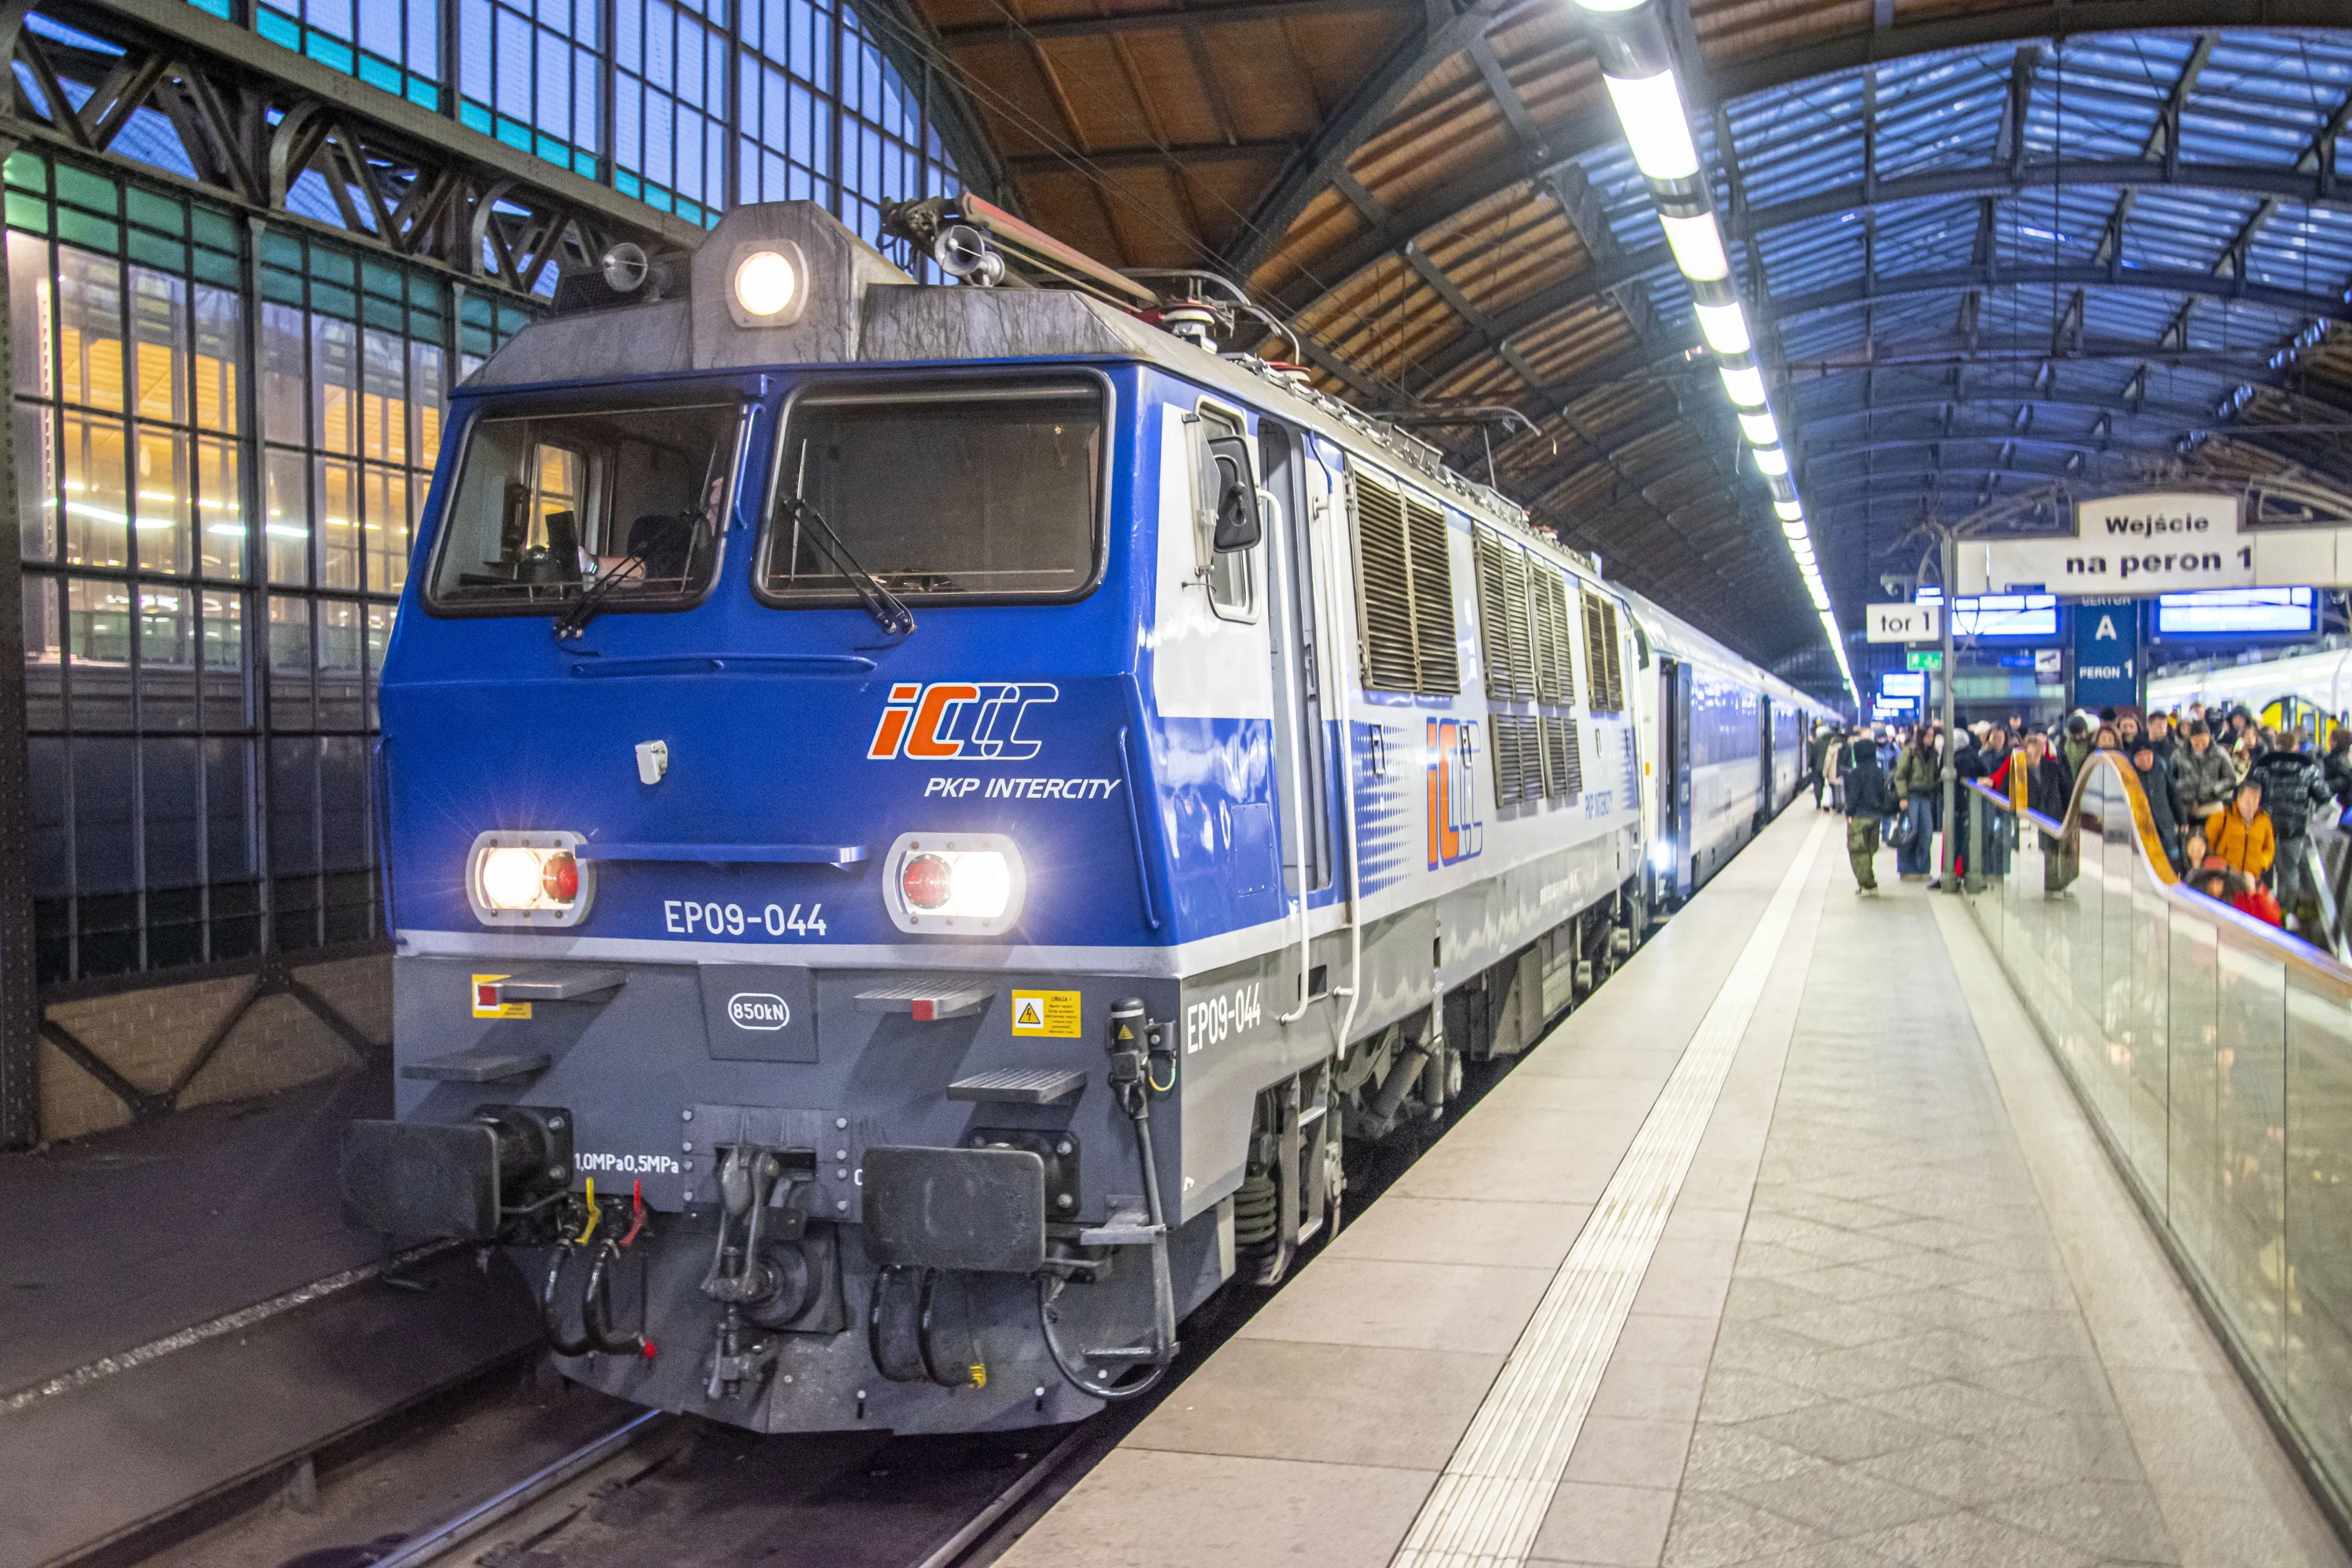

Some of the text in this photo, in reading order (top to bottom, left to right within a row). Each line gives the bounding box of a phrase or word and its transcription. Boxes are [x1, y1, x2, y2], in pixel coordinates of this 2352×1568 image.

[2105, 513, 2209, 538] Wejście
[2067, 545, 2252, 579] na peron 1
[1880, 611, 1930, 633] tor 1
[2095, 614, 2117, 641] A
[2079, 659, 2133, 679] PERON 1
[924, 777, 1122, 799] PKP INTERCITY
[665, 900, 827, 936] EP09-044
[733, 1003, 784, 1021] 850kN
[1187, 982, 1261, 1054] EP09-044
[575, 1153, 679, 1174] 1,0MPa 0,5MPa
